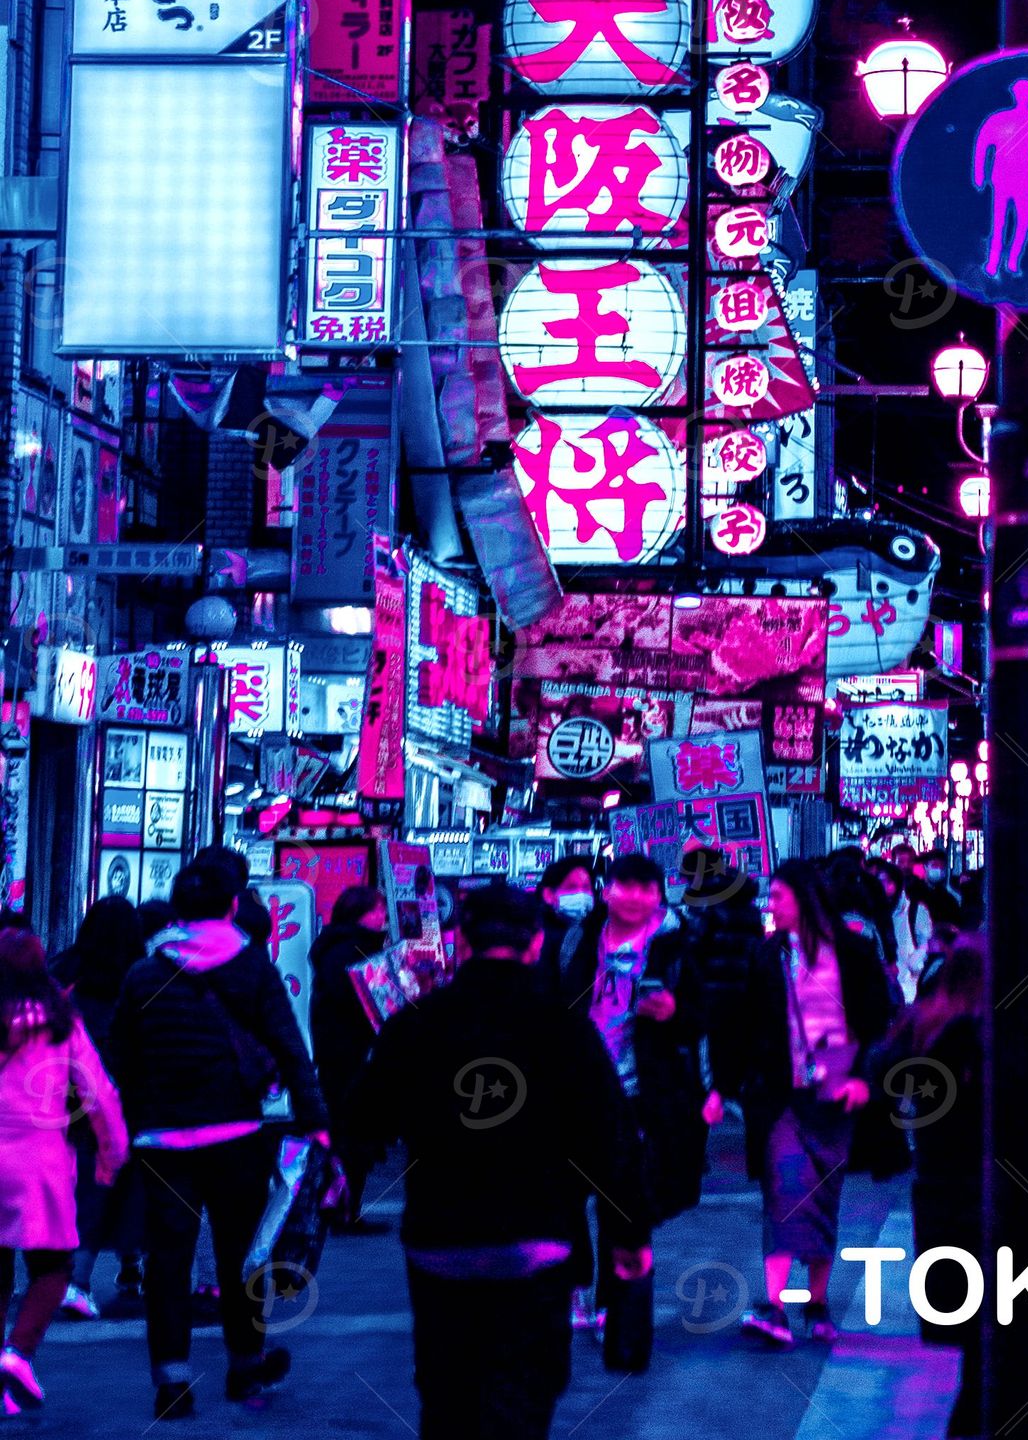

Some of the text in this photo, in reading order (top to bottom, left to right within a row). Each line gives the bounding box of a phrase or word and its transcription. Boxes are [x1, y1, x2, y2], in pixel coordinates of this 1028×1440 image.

[248, 31, 282, 50] 2F
[322, 127, 388, 186] 薬
[324, 194, 379, 312] ダイコク
[311, 316, 387, 344] 免税
[843, 726, 945, 764] わなか
[787, 769, 818, 786] 2F
